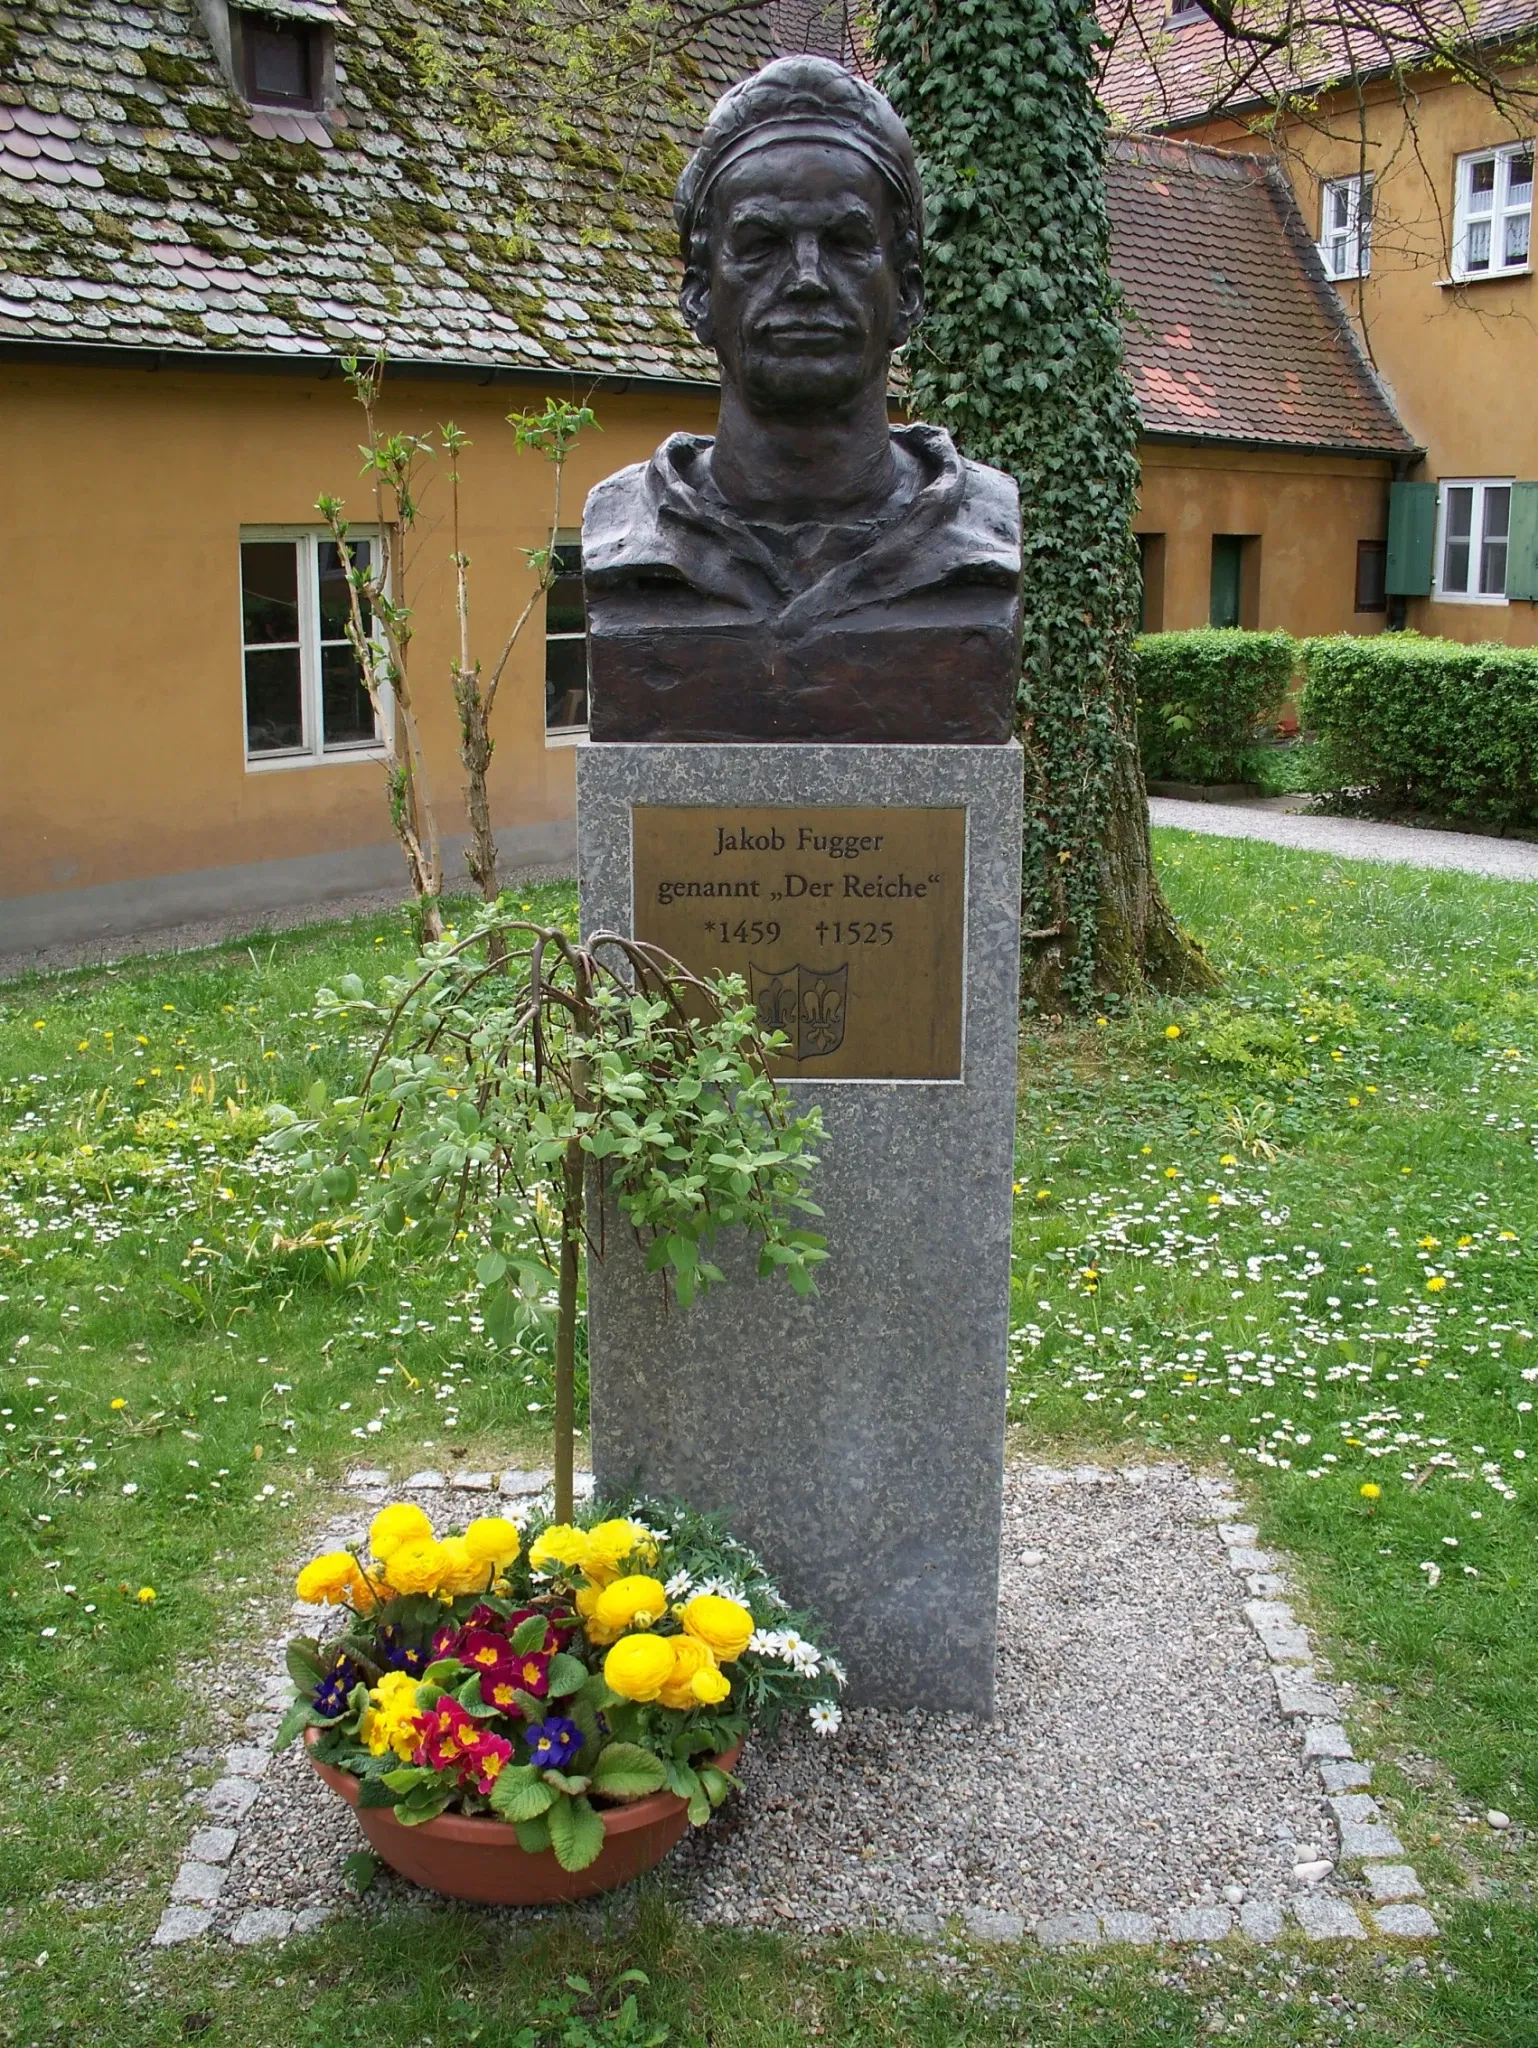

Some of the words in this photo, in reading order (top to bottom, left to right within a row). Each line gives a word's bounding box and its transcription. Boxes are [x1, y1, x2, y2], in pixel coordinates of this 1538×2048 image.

[714, 827, 785, 855] Jakob
[797, 827, 883, 858] Fugger
[658, 878, 759, 904] genannt
[770, 875, 833, 901] „Der
[843, 874, 941, 898] Reiche“
